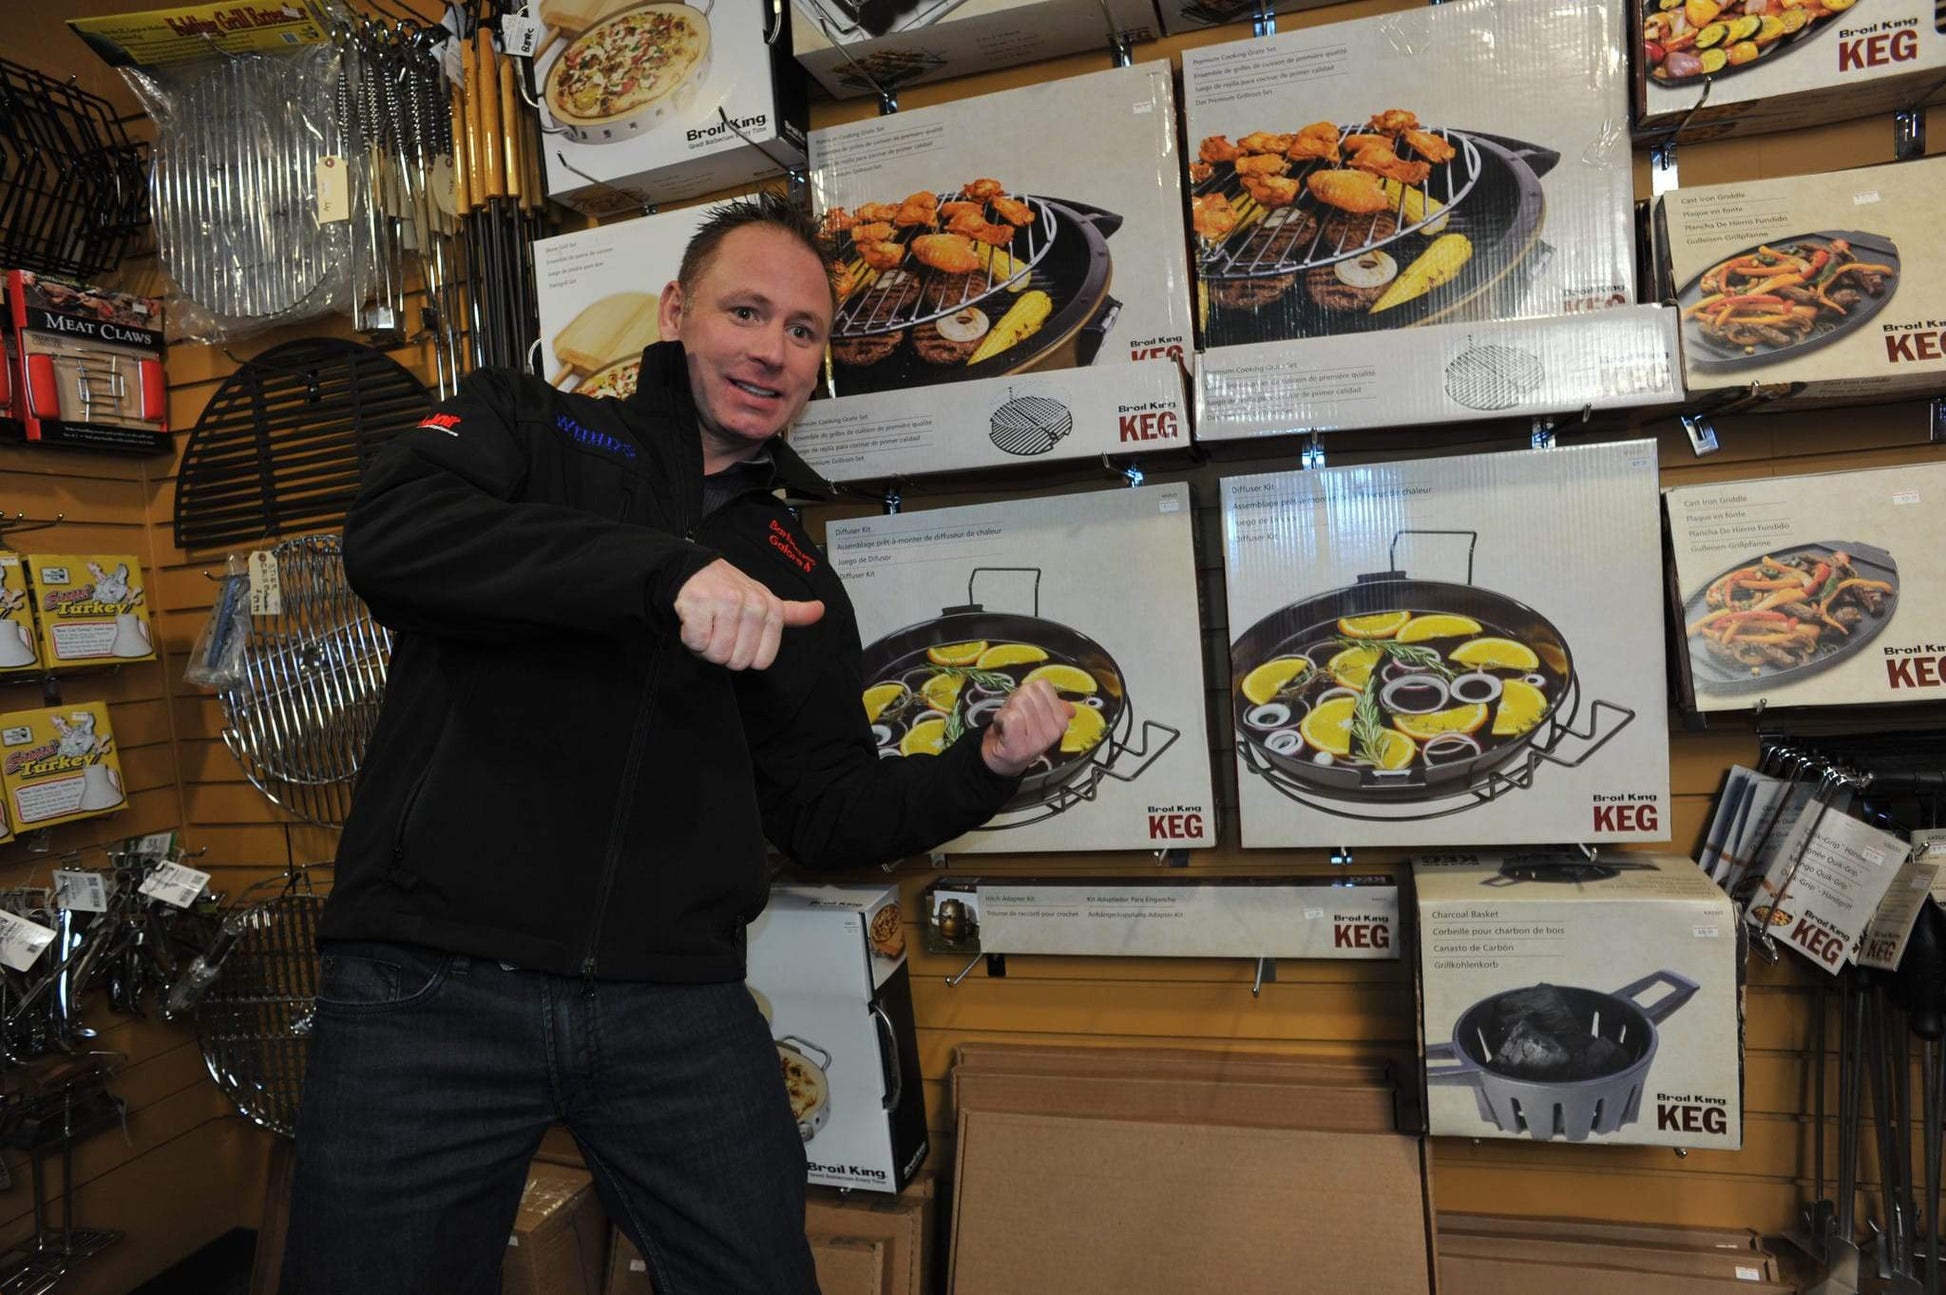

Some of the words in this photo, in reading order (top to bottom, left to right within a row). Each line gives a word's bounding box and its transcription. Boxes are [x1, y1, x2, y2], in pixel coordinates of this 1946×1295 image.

[1839, 24, 1878, 39] Broil
[1882, 17, 1918, 30] King
[1221, 52, 1247, 60] Cooking
[1839, 29, 1918, 72] KEG
[686, 122, 726, 141] Broil
[729, 114, 767, 129] King
[44, 312, 96, 335] MEAT
[100, 324, 152, 345] CLAWS
[1883, 321, 1922, 332] Broil
[1131, 338, 1156, 348] Broil
[1158, 335, 1183, 344] King
[1885, 331, 1946, 363] KE
[1118, 403, 1147, 412] Broil
[1150, 401, 1177, 410] King
[1119, 411, 1178, 442] KEG
[1232, 486, 1261, 494] Diffuser
[1402, 488, 1432, 496] chaleur
[837, 541, 875, 550] Assemblage
[839, 558, 857, 566] Juego
[57, 601, 128, 616] Turkey
[1884, 645, 1922, 655] Broil
[1886, 656, 1946, 689] KE
[20, 754, 96, 777] Turkey
[1593, 794, 1625, 802] Broil
[1628, 793, 1657, 801] King
[1147, 805, 1174, 813] Broil
[1177, 805, 1202, 813] King
[1593, 804, 1658, 832] KEG
[1148, 814, 1203, 839] KEG
[1334, 914, 1361, 922] Broil
[1363, 914, 1389, 923] King
[1432, 911, 1468, 919] Charcoal
[1495, 927, 1530, 935] charbon
[1805, 909, 1829, 928] Broil
[1829, 923, 1850, 942] King
[1334, 924, 1389, 949] KEG
[1790, 918, 1844, 966] KEG
[1435, 961, 1499, 969] Grillkohlenkorb
[1657, 1093, 1690, 1102] Broil
[1694, 1095, 1727, 1106] King
[1658, 1104, 1727, 1135] KEG
[807, 1162, 845, 1174] Broil
[850, 1165, 886, 1180] King
